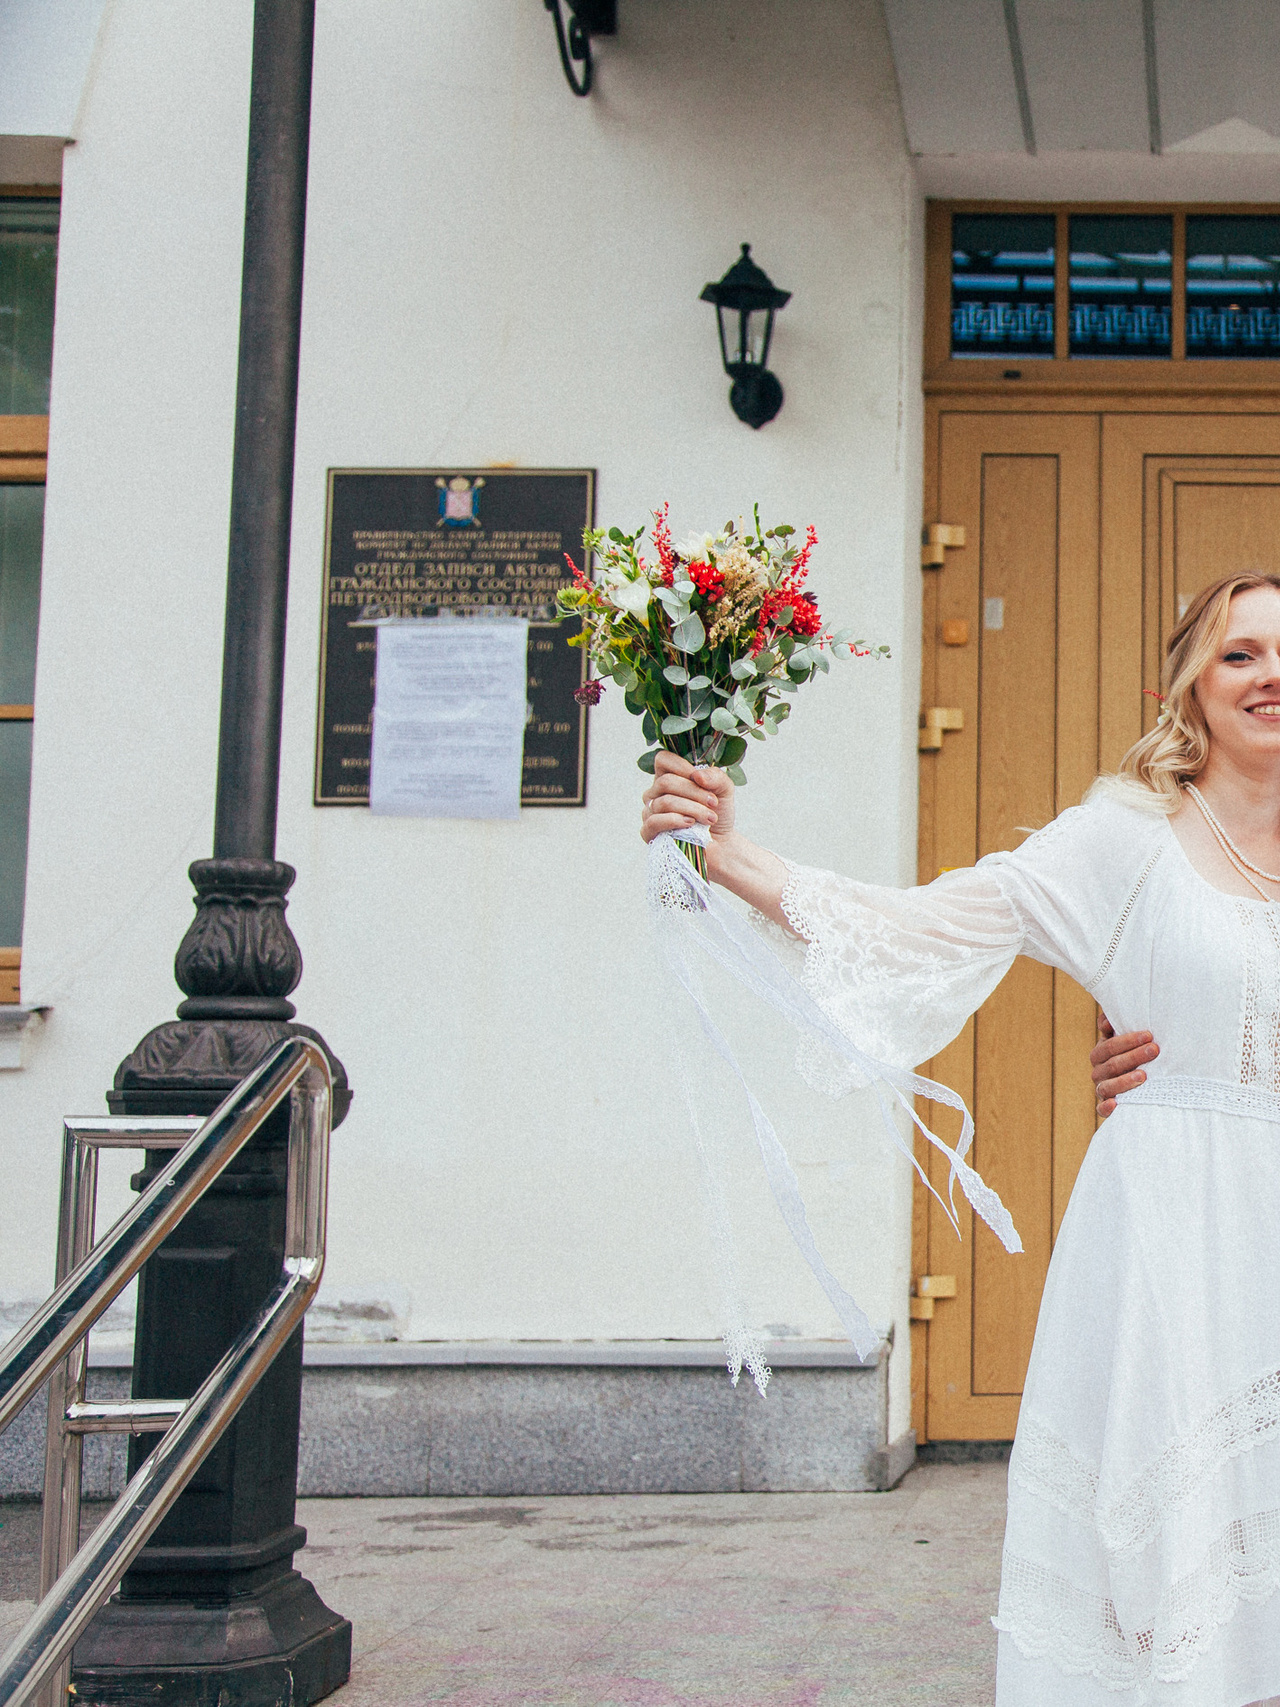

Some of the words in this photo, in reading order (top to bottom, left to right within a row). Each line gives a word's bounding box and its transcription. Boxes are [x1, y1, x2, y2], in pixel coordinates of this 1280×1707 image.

[354, 562, 416, 576] ОТДЕЛ
[423, 562, 496, 576] ЗАПИСИ
[503, 563, 562, 577] АКТОВ
[330, 576, 471, 591] ГРАЖДАНСКОГО
[477, 577, 573, 591] СОСТОЯНИ
[331, 591, 507, 606] ПЕТРОДВОРЦОВОГО
[511, 591, 557, 606] РАЙО
